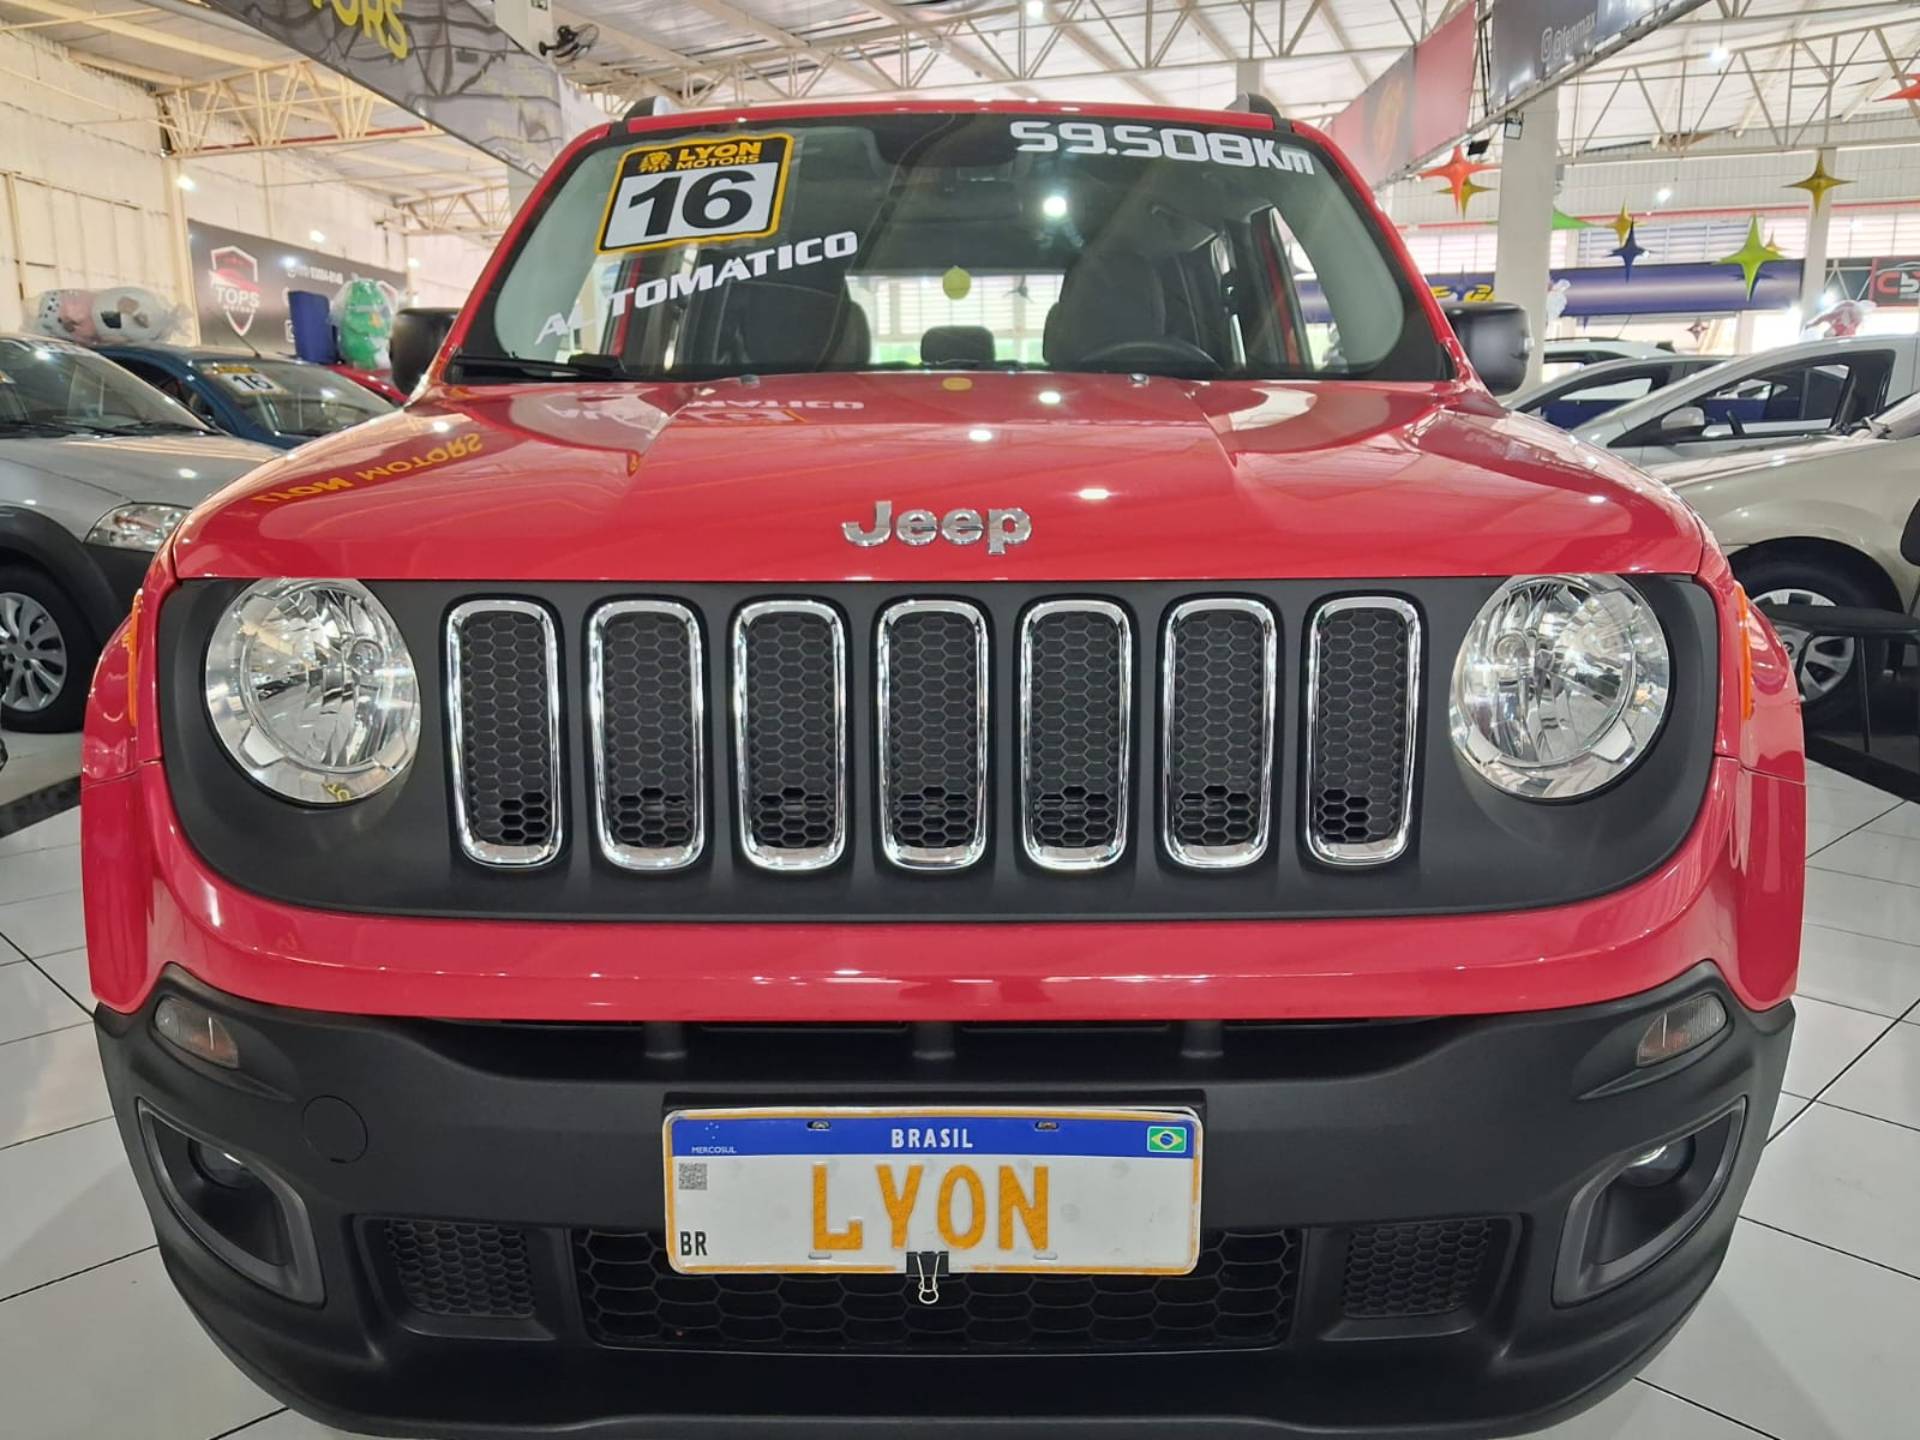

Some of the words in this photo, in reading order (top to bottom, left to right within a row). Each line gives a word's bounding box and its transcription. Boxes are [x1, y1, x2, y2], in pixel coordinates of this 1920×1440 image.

[676, 152, 760, 171] MOTORS
[677, 141, 761, 162] LYON
[628, 169, 754, 237] 16
[215, 287, 261, 308] TOPS
[840, 500, 1032, 556] Jeep
[891, 1127, 974, 1149] BRASIL
[691, 1145, 737, 1154] MERCOSUL
[811, 1162, 1050, 1251] LYON
[679, 1230, 708, 1257] BR
